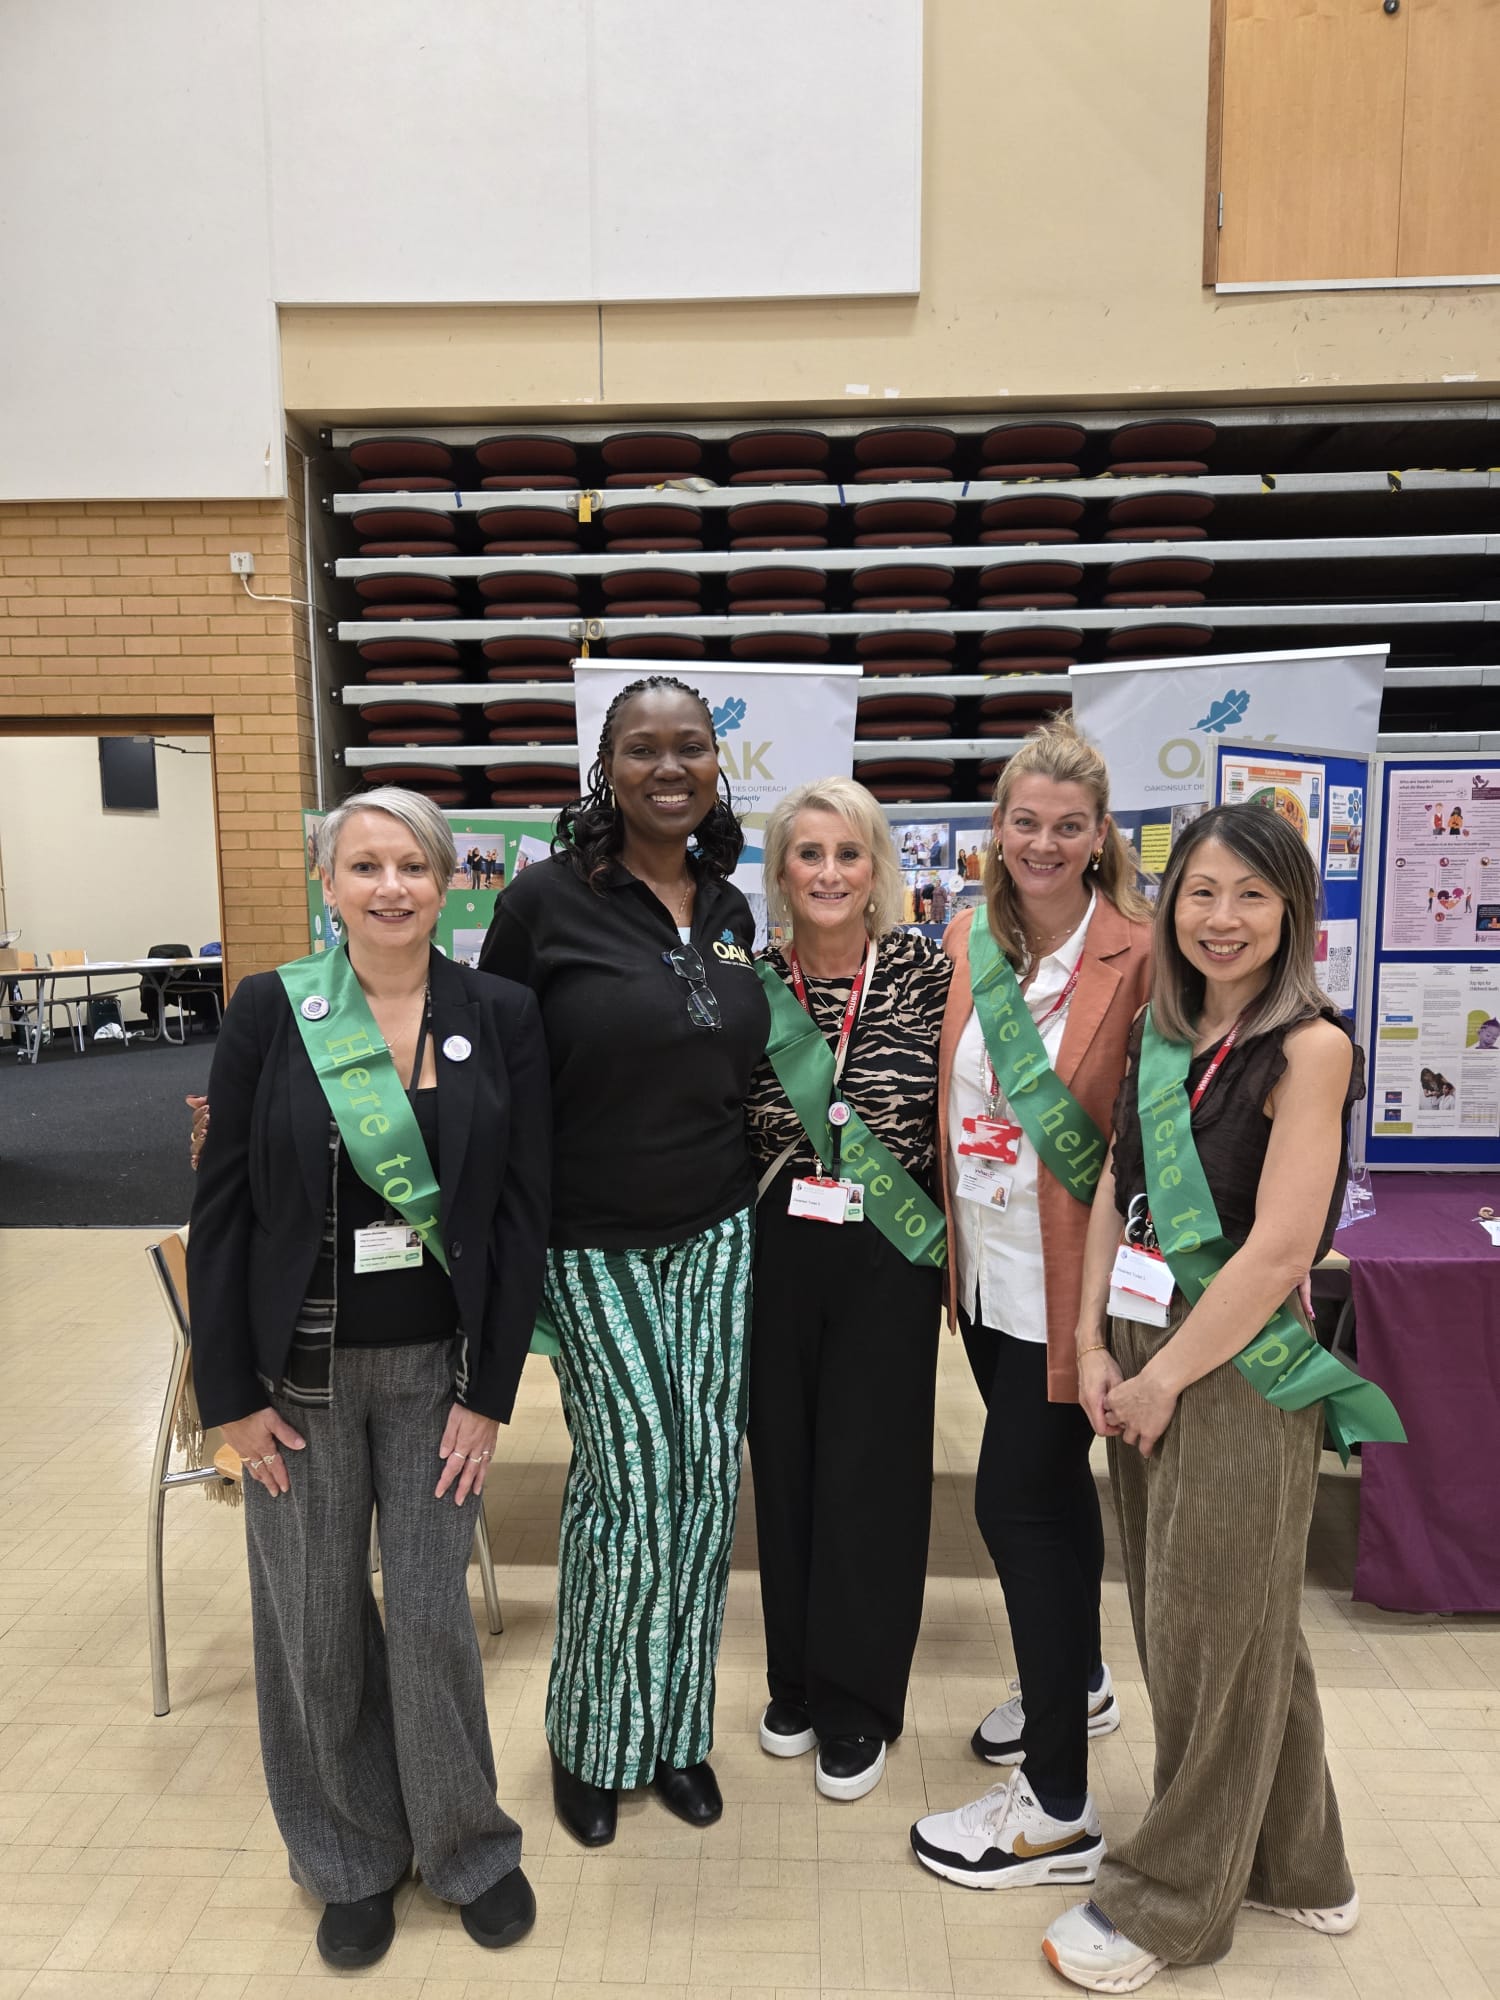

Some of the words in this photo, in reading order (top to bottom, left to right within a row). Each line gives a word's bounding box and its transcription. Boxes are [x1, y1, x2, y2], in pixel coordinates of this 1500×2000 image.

[717, 741, 775, 780] AK
[747, 785, 787, 793] OUTREACH
[1144, 784, 1193, 792] OAKONSULT
[712, 941, 752, 966] OAK
[847, 990, 859, 1016] VISITOR
[1197, 1063, 1219, 1091] VISITOR
[326, 1026, 390, 1137] Here
[375, 1153, 413, 1203] to
[1012, 1051, 1039, 1094] to
[1036, 1097, 1101, 1189] help
[894, 1197, 927, 1237] to
[1170, 1206, 1202, 1254] to
